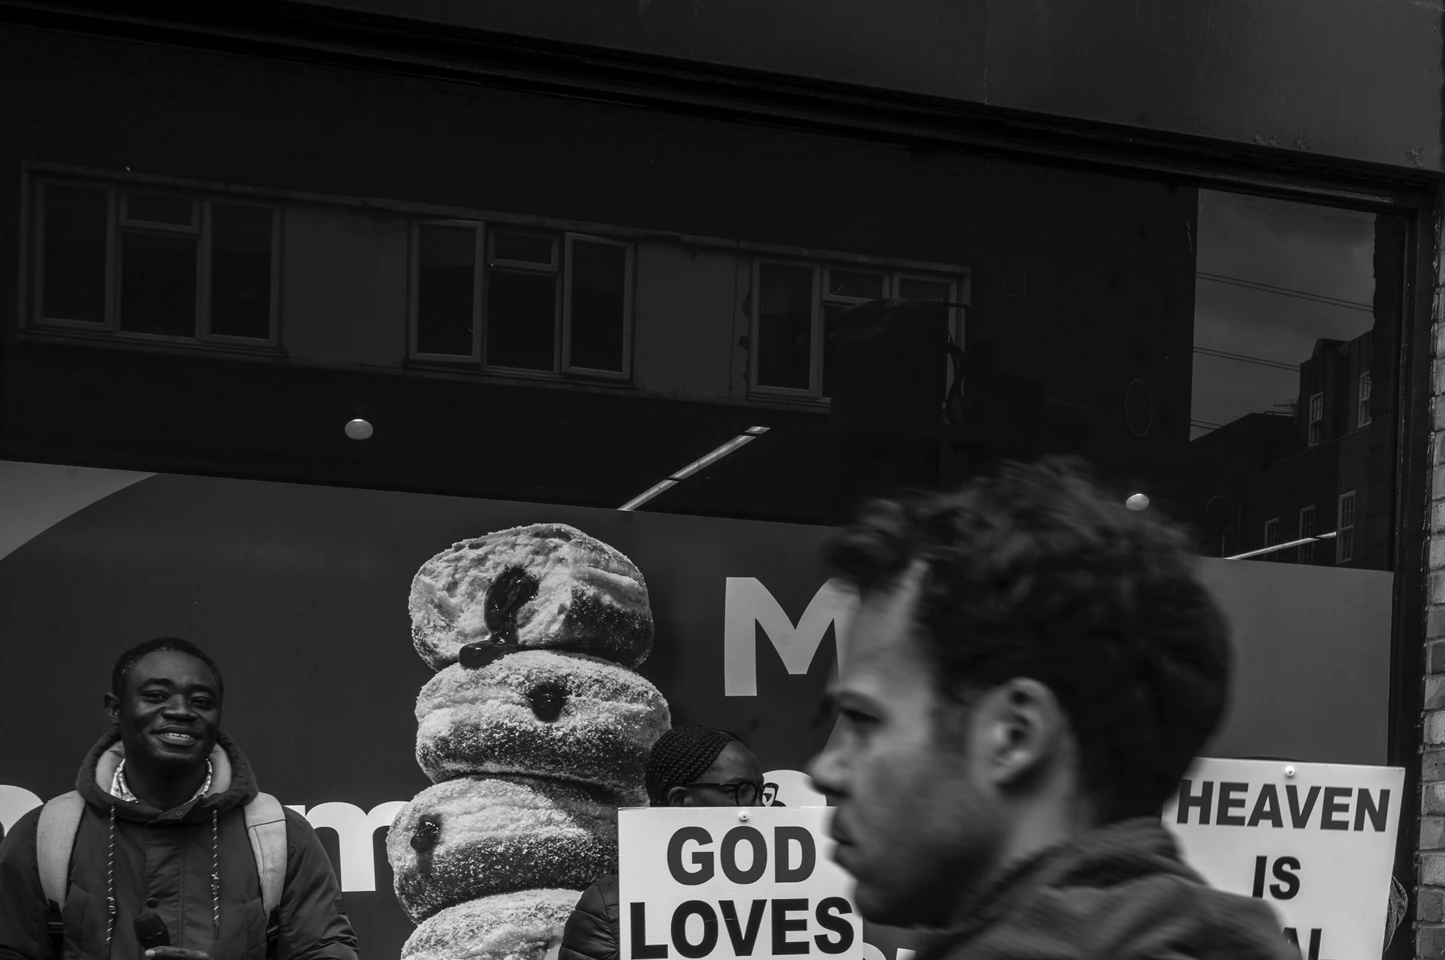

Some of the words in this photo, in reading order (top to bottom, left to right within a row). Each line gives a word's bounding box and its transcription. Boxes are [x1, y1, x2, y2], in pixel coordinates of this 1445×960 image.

[1176, 779, 1391, 832] HEAVEN
[667, 826, 816, 886] GOD
[1252, 855, 1301, 900] IS
[629, 896, 855, 960] LOVES
